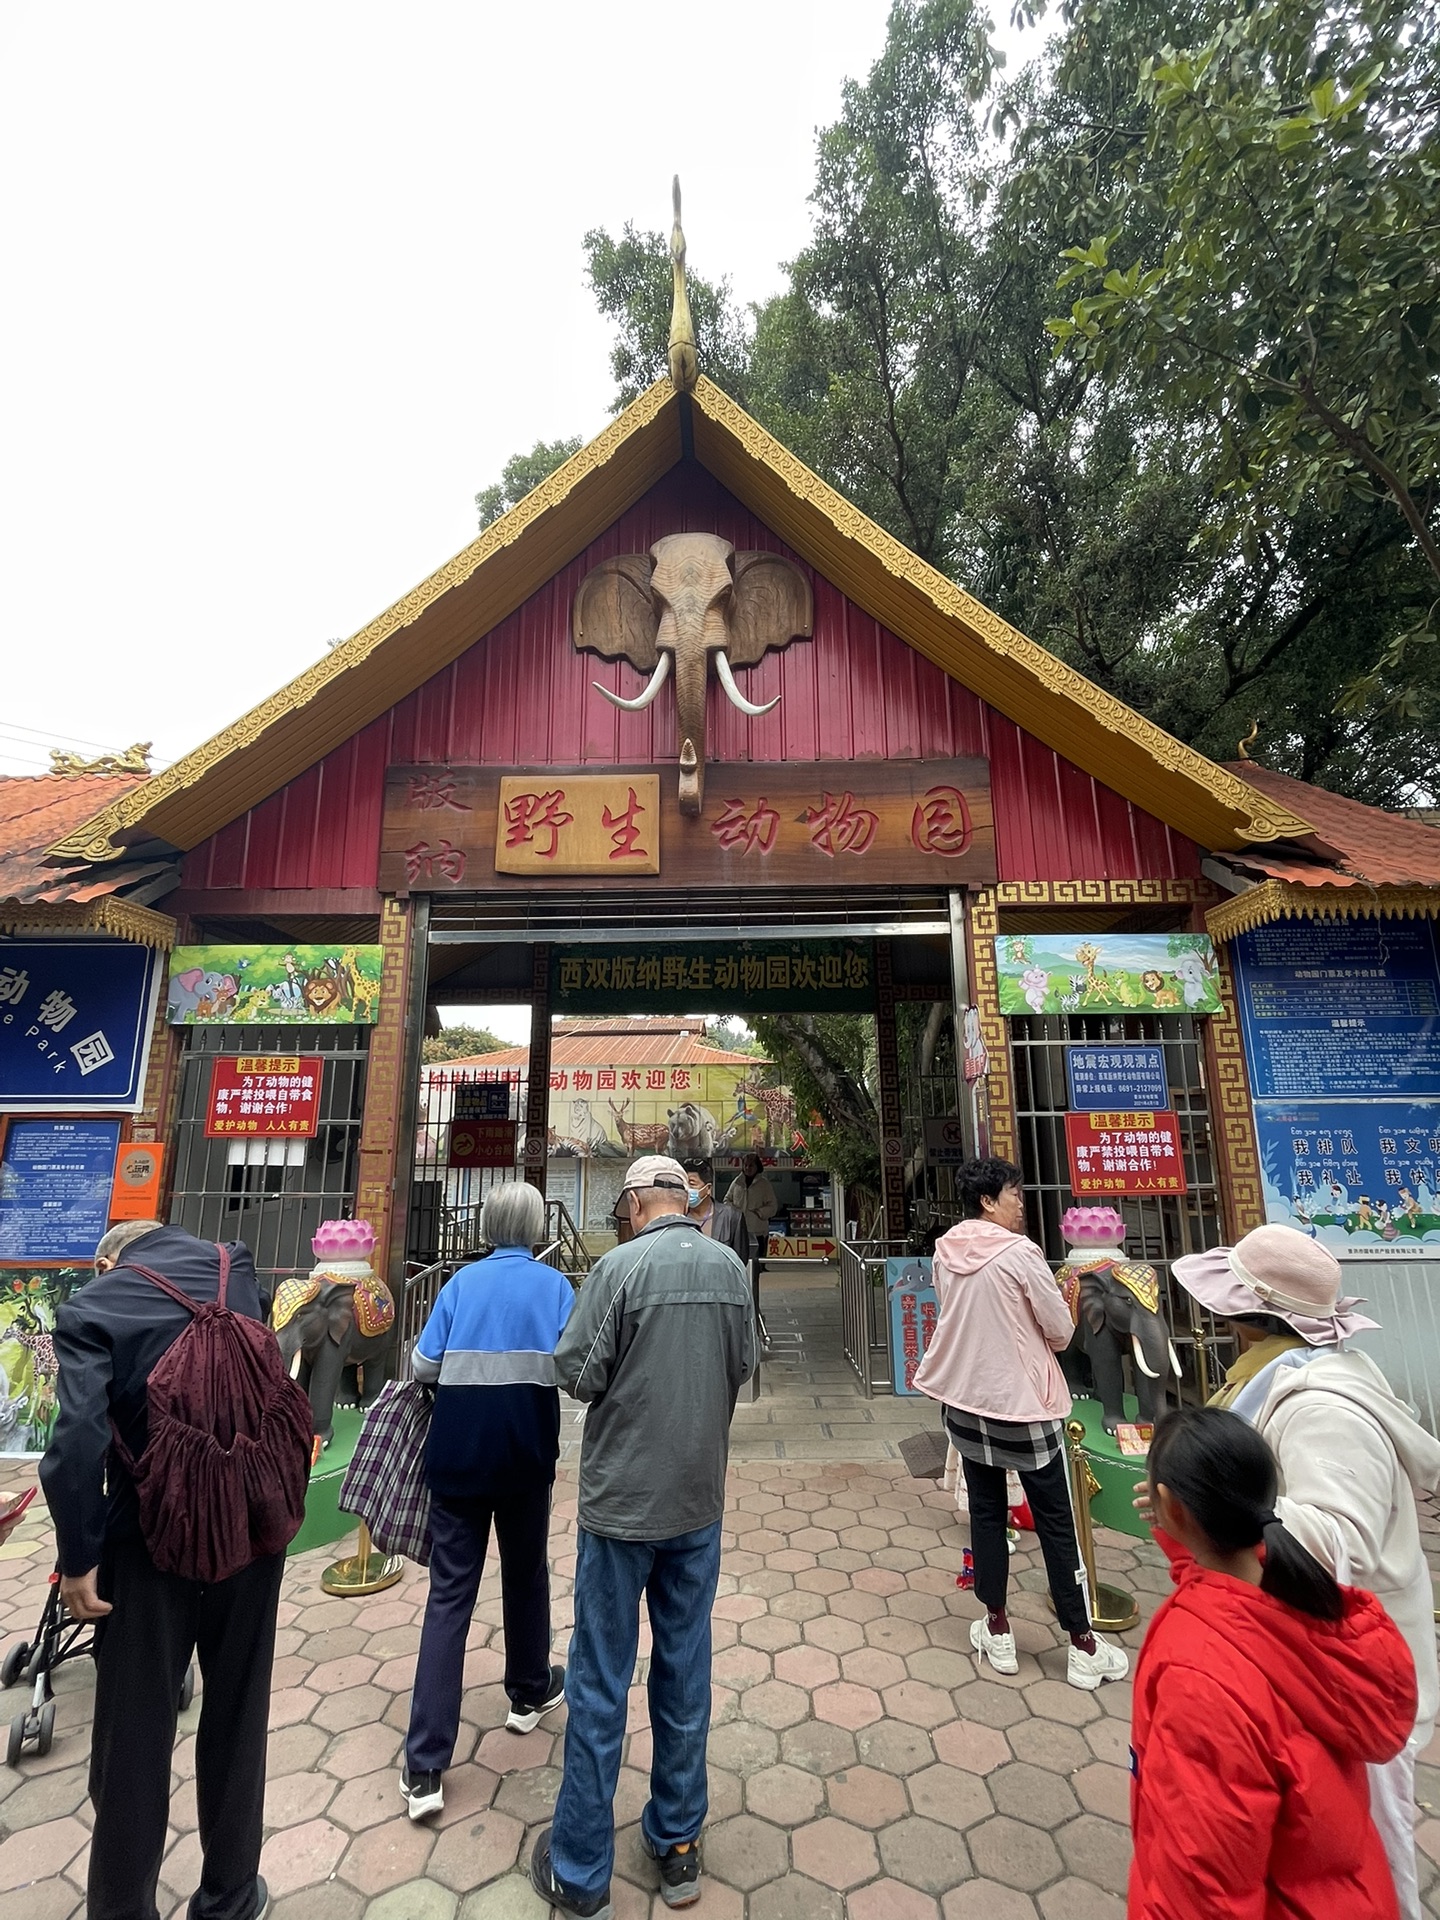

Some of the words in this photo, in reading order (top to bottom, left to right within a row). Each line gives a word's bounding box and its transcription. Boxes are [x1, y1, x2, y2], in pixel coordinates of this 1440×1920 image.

[710, 784, 974, 858] 动物园
[559, 955, 869, 990] 西双版纳野生动物园欢迎您
[25, 1025, 67, 1074] Park
[240, 1058, 296, 1072] 温馨提示
[1072, 1053, 1160, 1069] 地震宏观观测点
[242, 1075, 314, 1088] 为了动物的健
[217, 1088, 313, 1101] 康严禁投喂自带食
[214, 1120, 258, 1131] 爱护动物
[265, 1120, 310, 1131] 人人有责
[1093, 1113, 1151, 1128] 温馨提示
[1099, 1130, 1173, 1145] 为了动物的健
[1076, 1144, 1175, 1158] 康严禁投喂自带食
[1293, 1138, 1358, 1155] 我排队
[1080, 1178, 1125, 1190] 爱护动物
[1134, 1176, 1179, 1188] 人人有责
[1298, 1169, 1363, 1186] 我礼让
